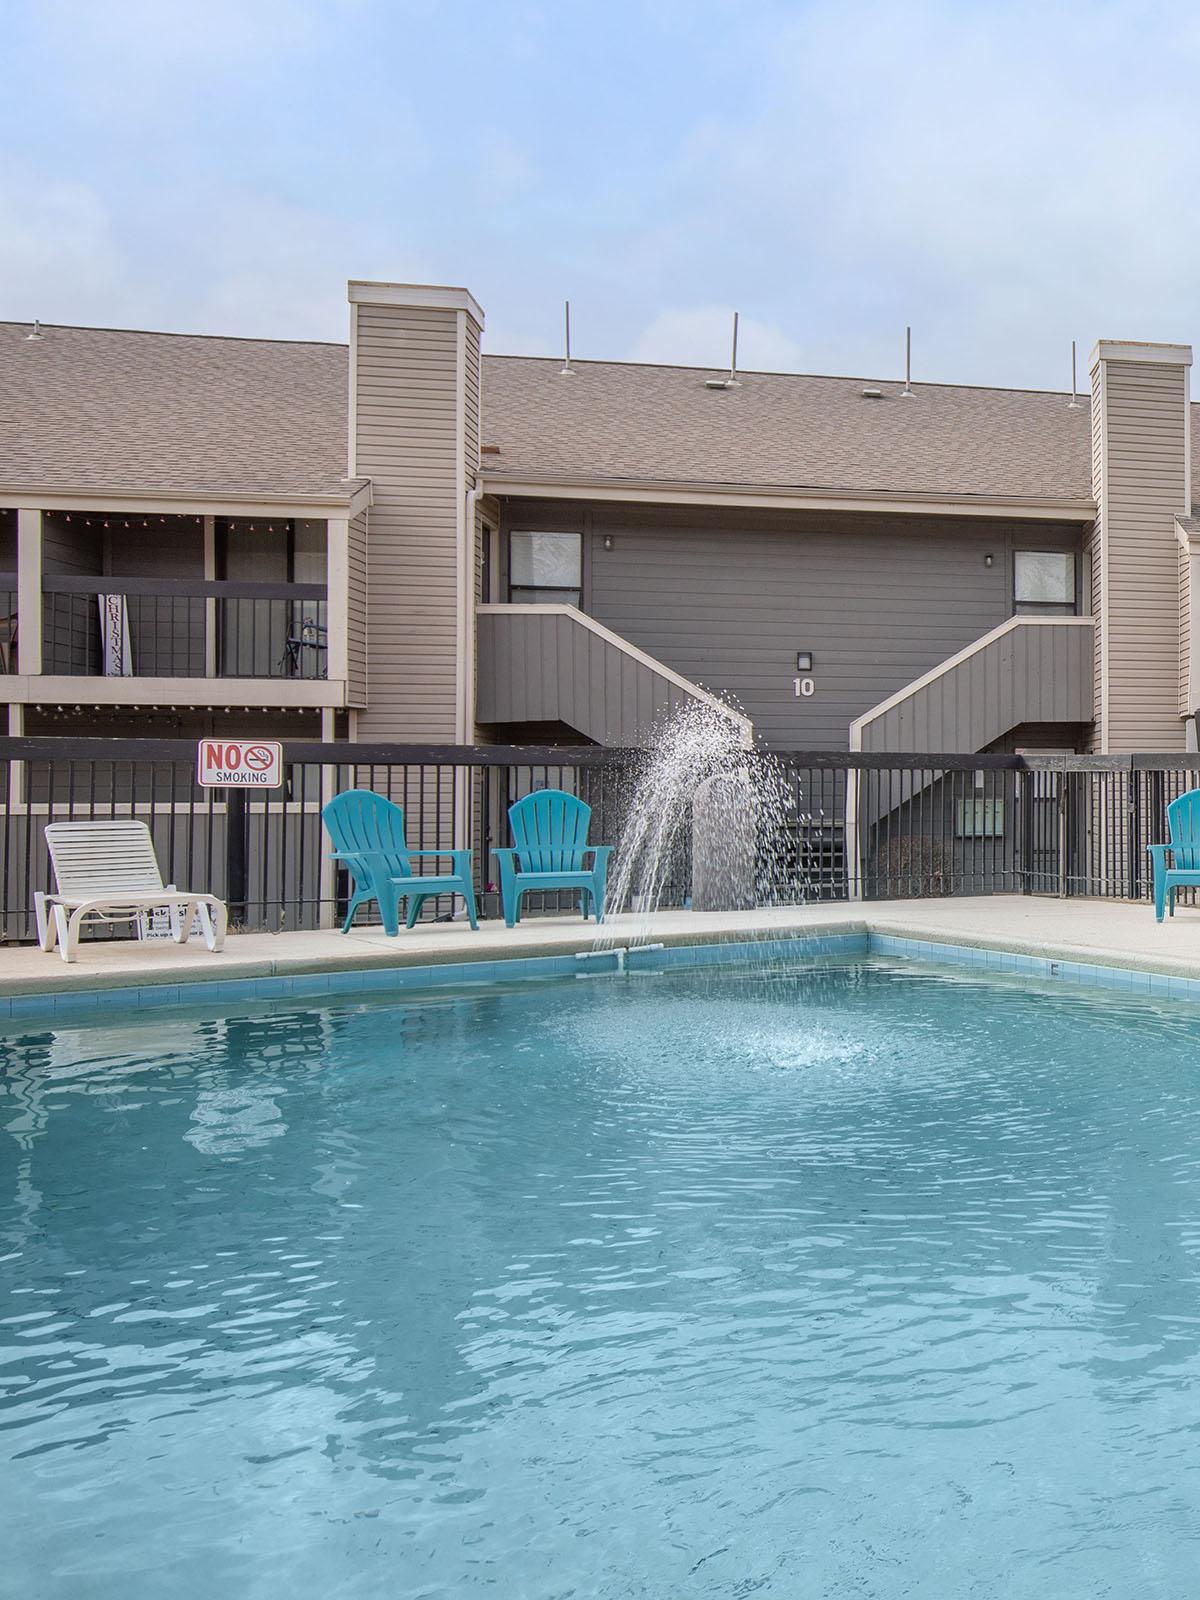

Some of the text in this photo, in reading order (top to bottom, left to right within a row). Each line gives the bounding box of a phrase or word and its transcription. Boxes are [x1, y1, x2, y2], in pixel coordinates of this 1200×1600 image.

[793, 678, 815, 697] 10
[206, 743, 241, 771] NO
[216, 771, 267, 783] SMOKING
